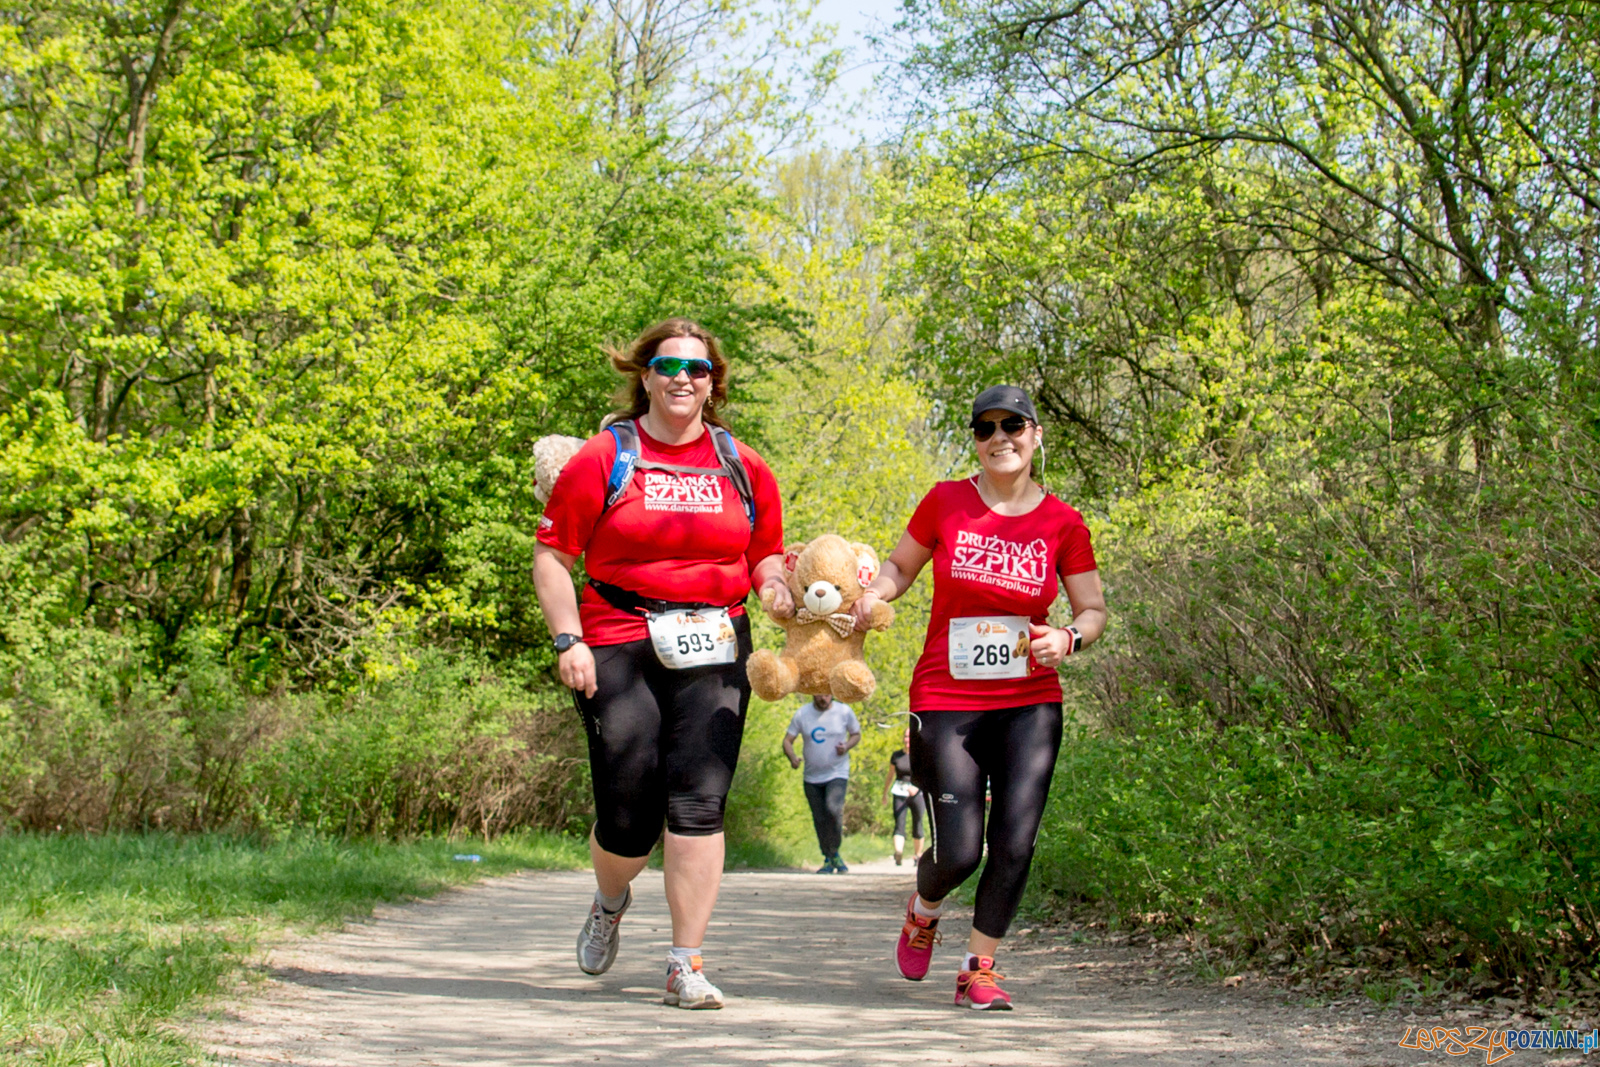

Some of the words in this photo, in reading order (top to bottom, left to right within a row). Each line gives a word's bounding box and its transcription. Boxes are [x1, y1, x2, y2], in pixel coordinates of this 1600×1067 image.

[644, 484, 723, 502] SZPIKU
[644, 503, 723, 514] www.darszpiku.pl
[956, 530, 1033, 559] DRUŻYNA
[951, 546, 1048, 582] SZPIKU
[951, 570, 1042, 597] www.darszpiku.pl
[677, 633, 715, 655] 593
[973, 644, 1010, 666] 269
